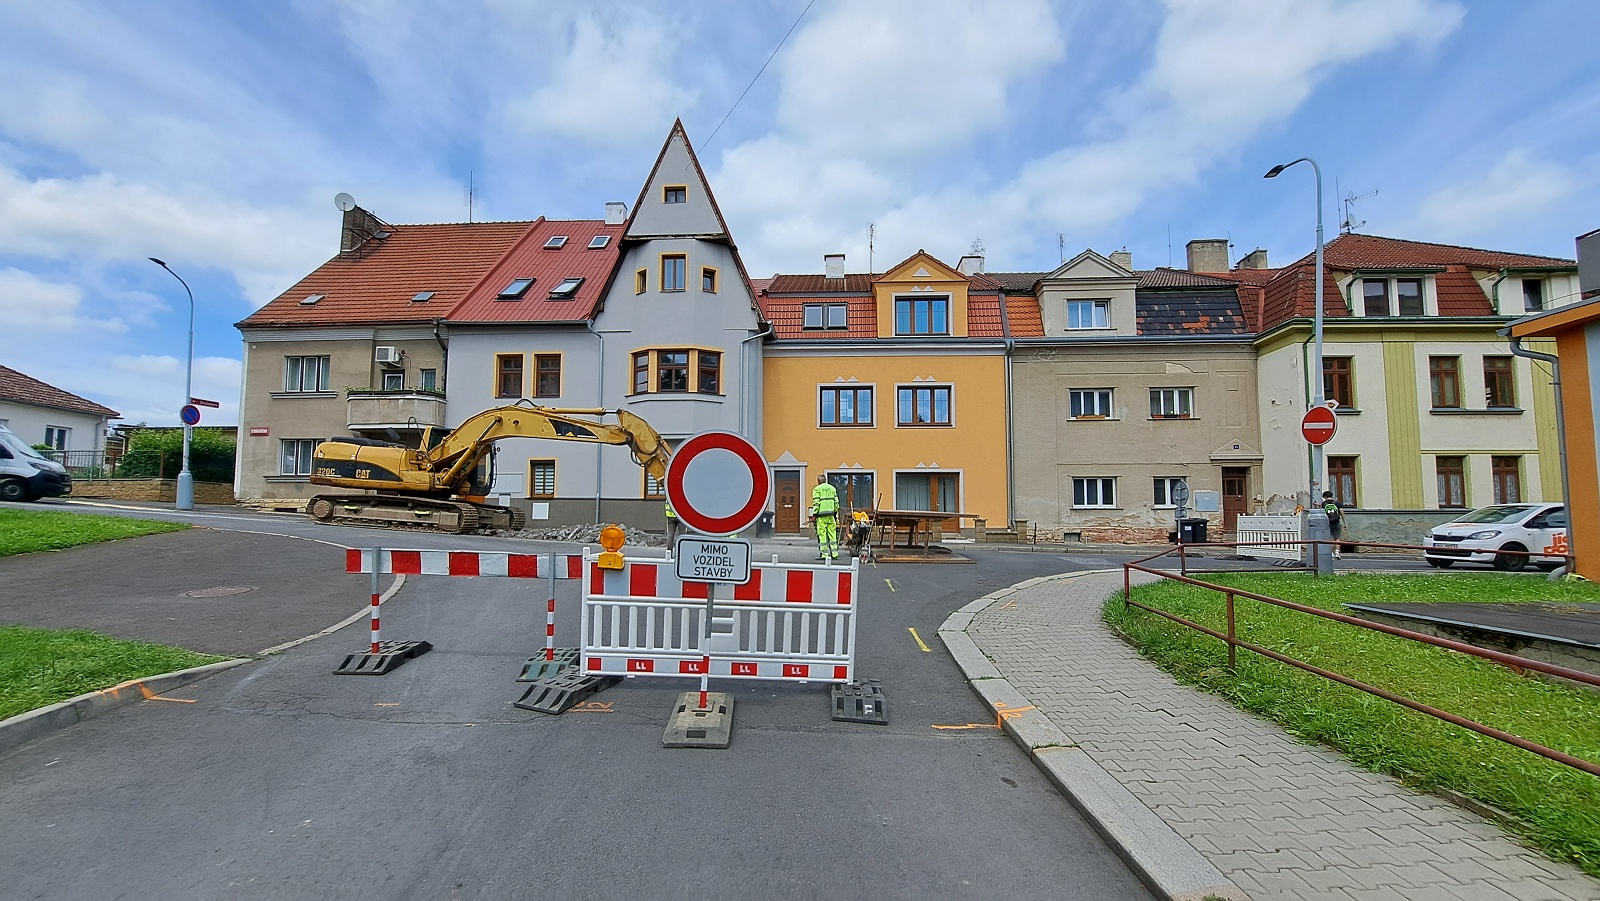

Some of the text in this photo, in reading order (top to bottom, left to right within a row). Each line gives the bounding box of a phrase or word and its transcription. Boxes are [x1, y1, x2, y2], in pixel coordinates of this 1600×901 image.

[317, 467, 336, 475] 320C
[355, 469, 371, 479] CAT
[701, 544, 729, 555] MIMO
[693, 555, 735, 567] VOZIDEL
[694, 566, 733, 578] STAVBY
[635, 661, 647, 670] LL
[688, 663, 699, 672] LL
[739, 664, 751, 673] LL
[791, 666, 802, 674] LL
